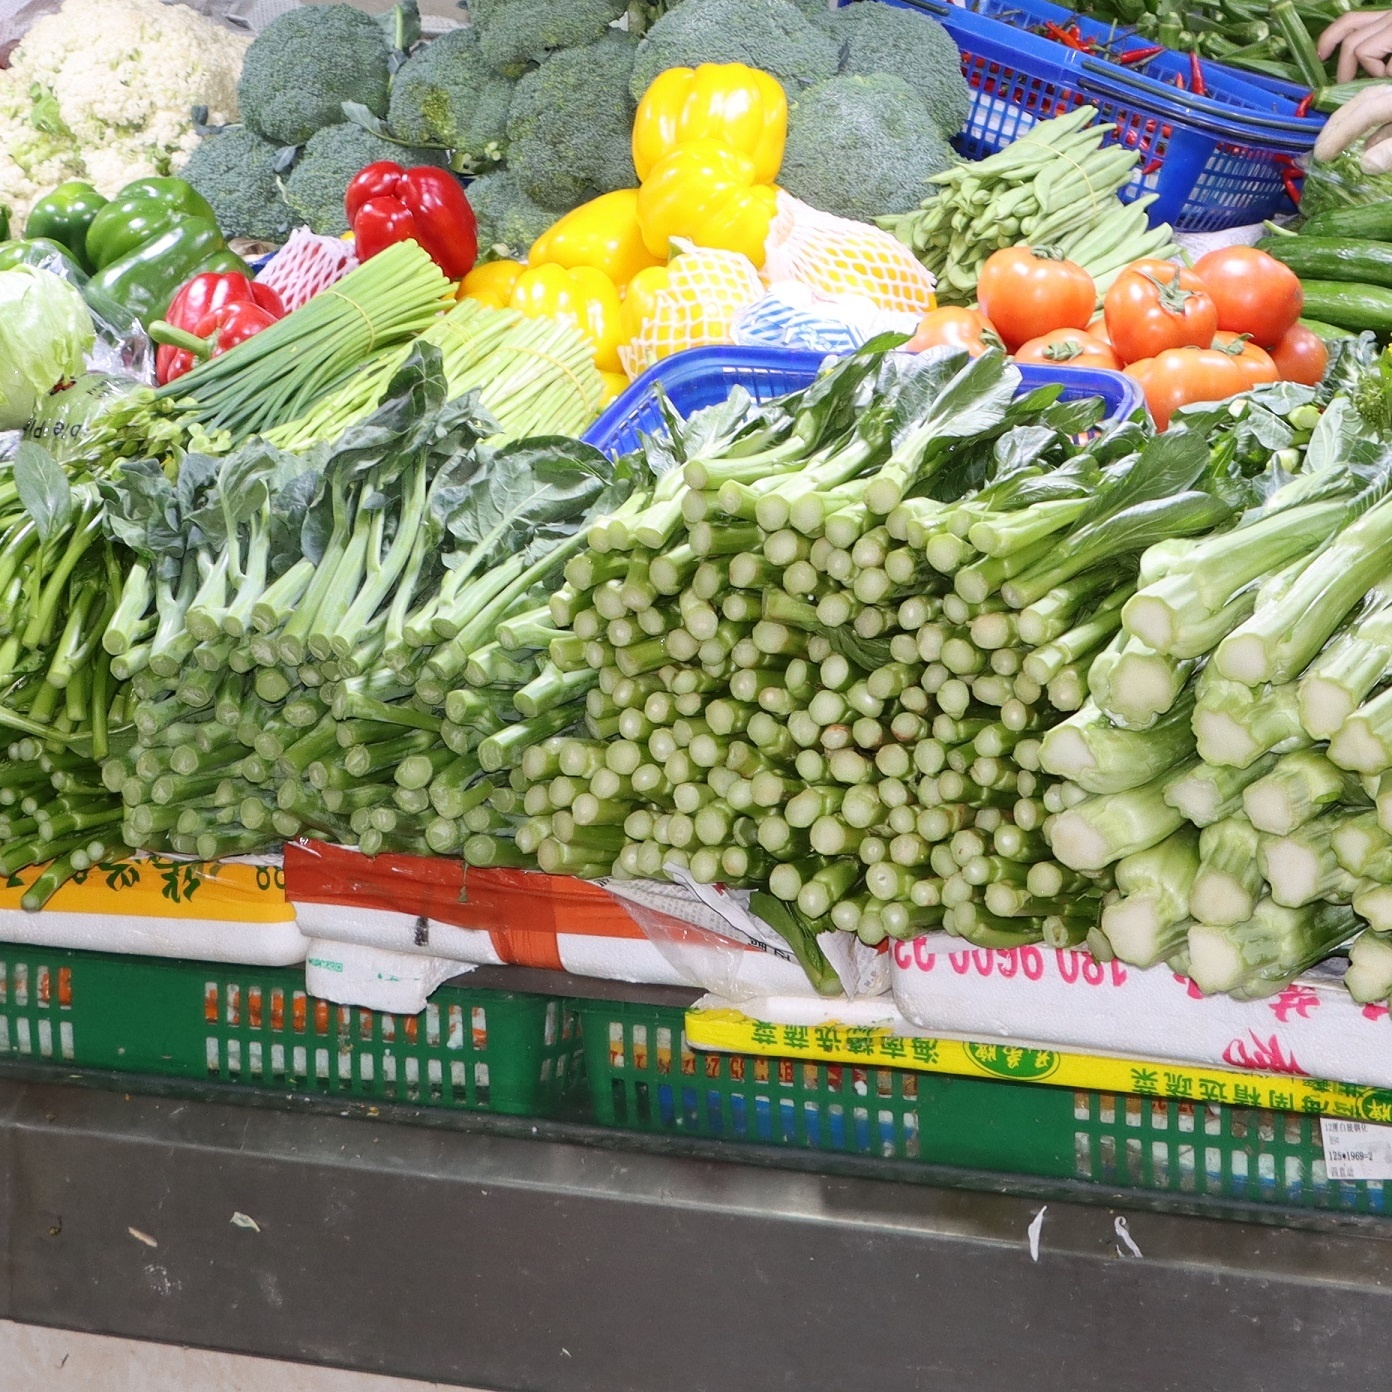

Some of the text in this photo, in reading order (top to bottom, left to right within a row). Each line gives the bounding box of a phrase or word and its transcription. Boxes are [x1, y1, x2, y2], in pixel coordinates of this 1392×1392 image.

[1130, 1067, 1330, 1116] 海南精选蔬菜
